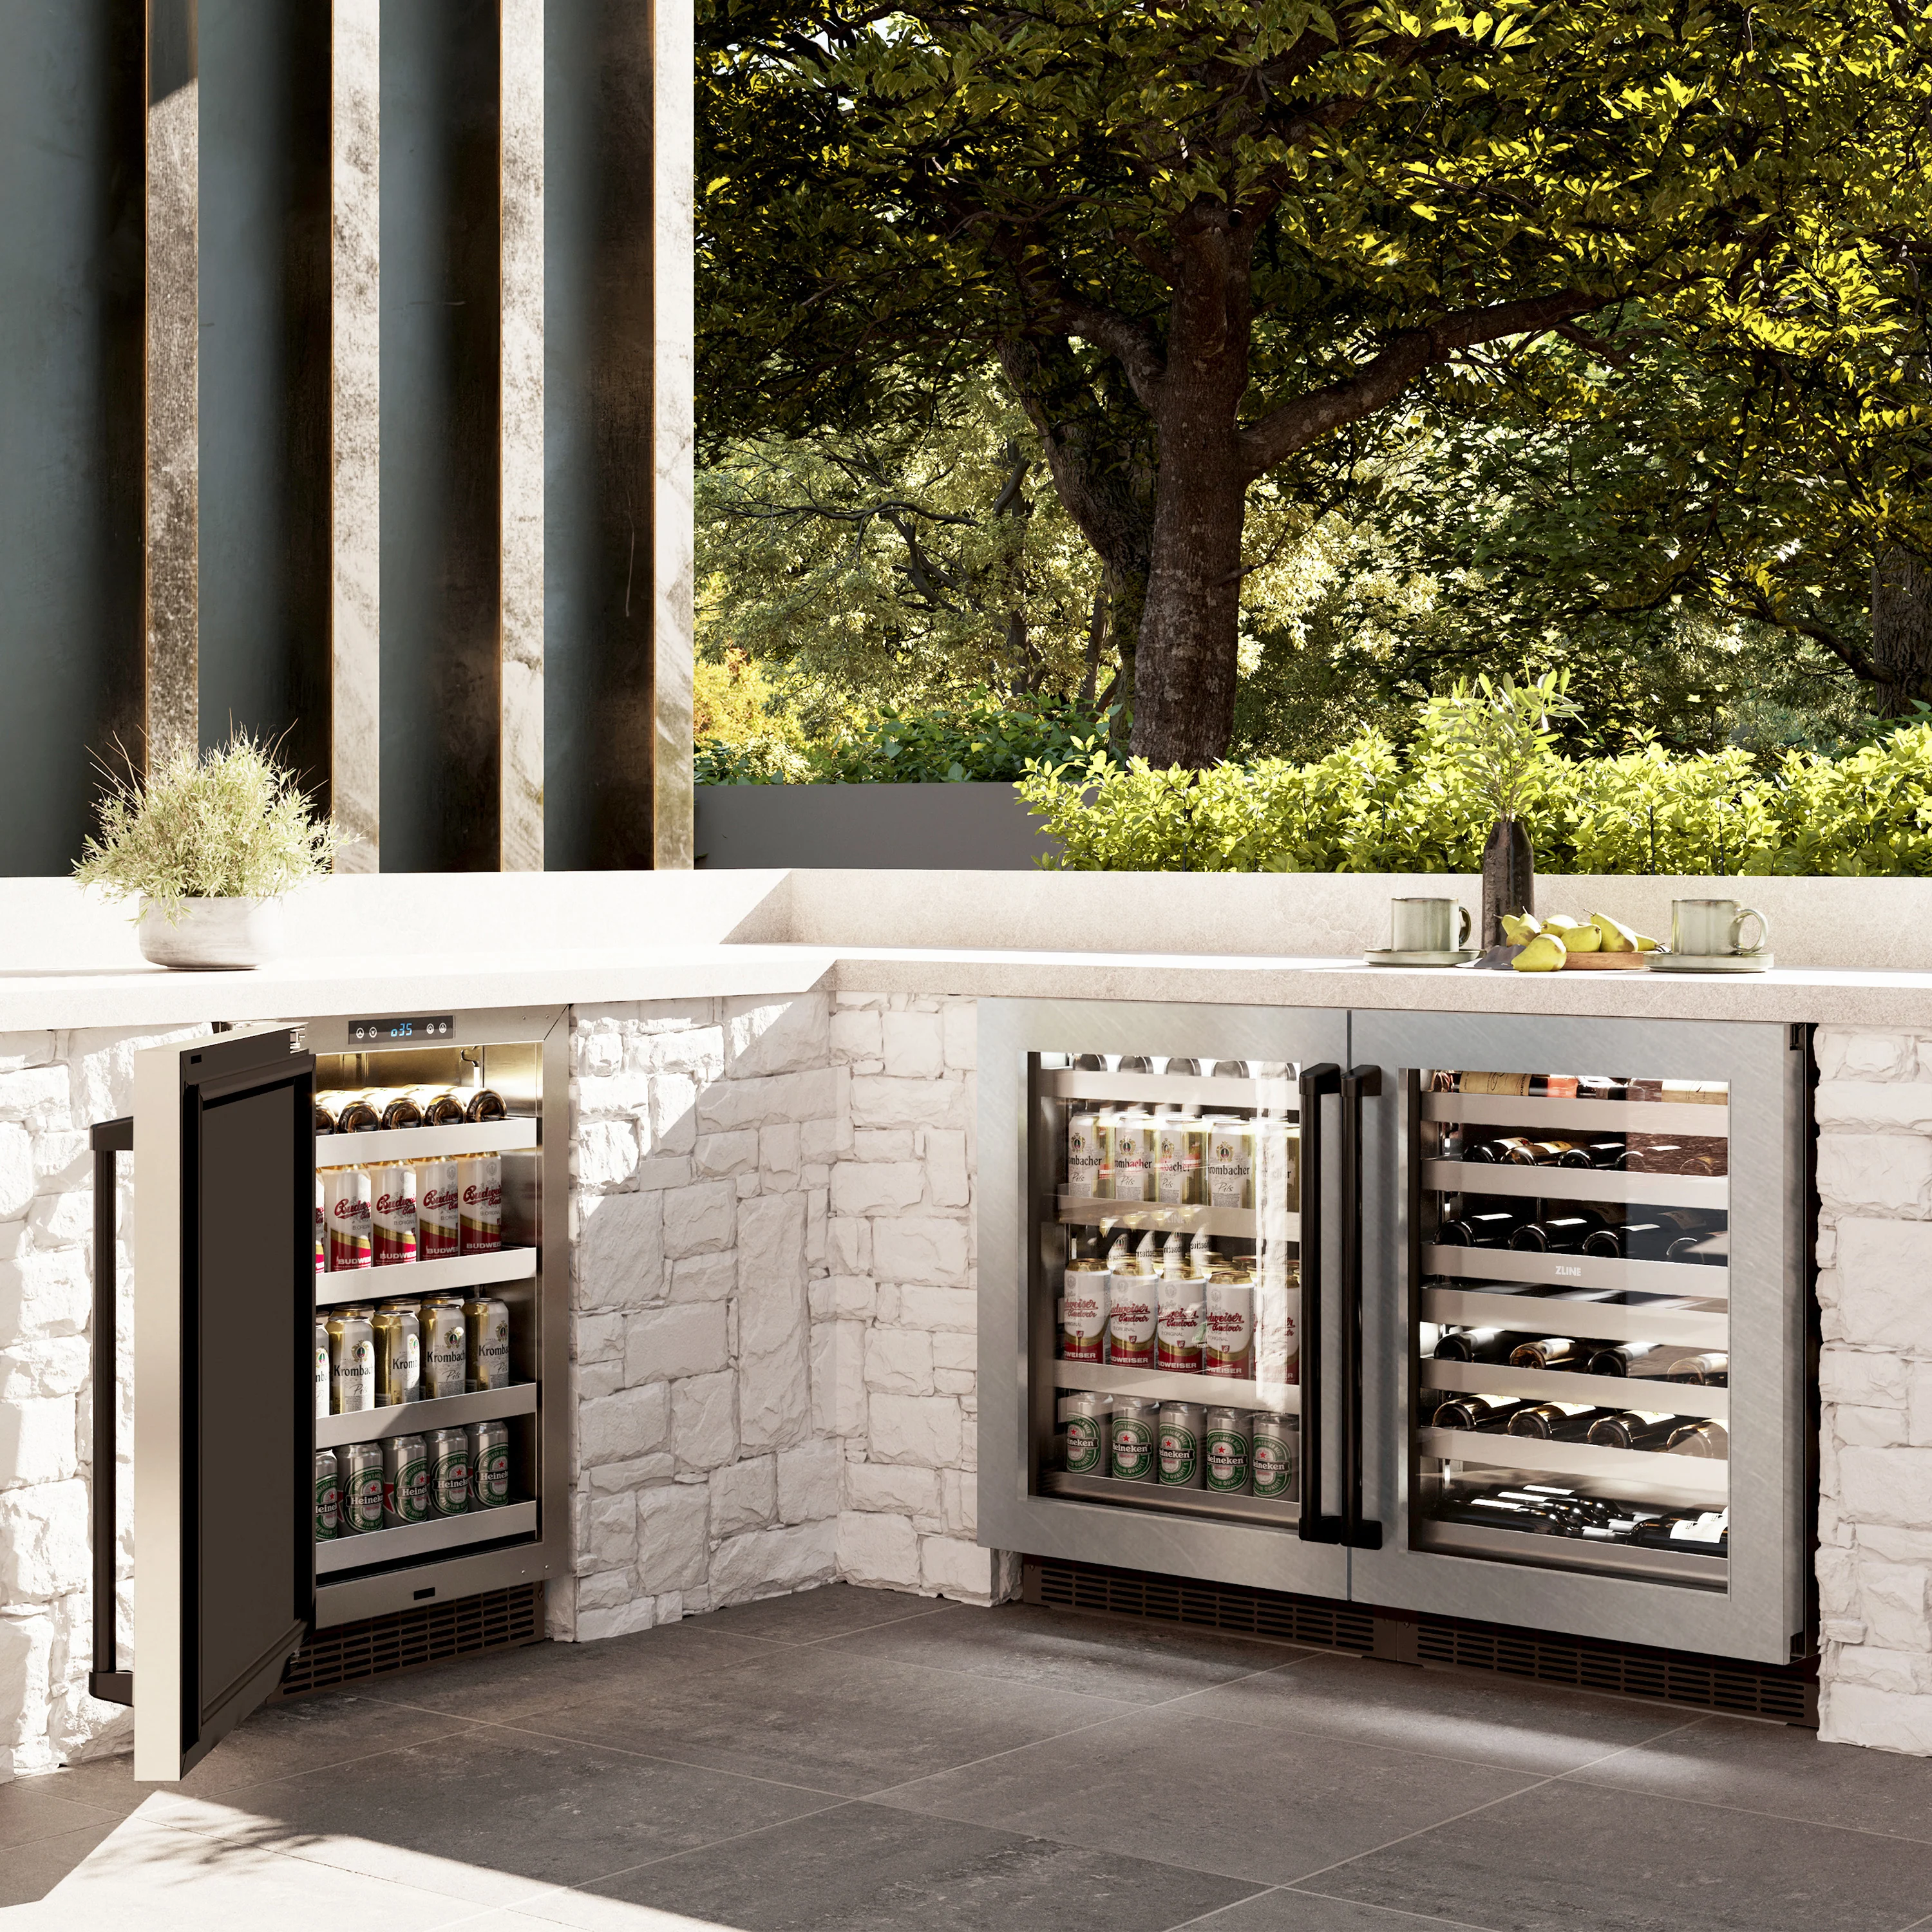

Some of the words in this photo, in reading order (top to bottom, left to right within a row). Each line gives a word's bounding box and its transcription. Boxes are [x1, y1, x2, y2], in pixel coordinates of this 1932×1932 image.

[1215, 1182, 1233, 1193] Pils
[1555, 1265, 1582, 1276] ZLINE
[334, 1363, 374, 1377] Krombac
[441, 1369, 461, 1382] Pils
[1207, 1454, 1244, 1464] Heineken
